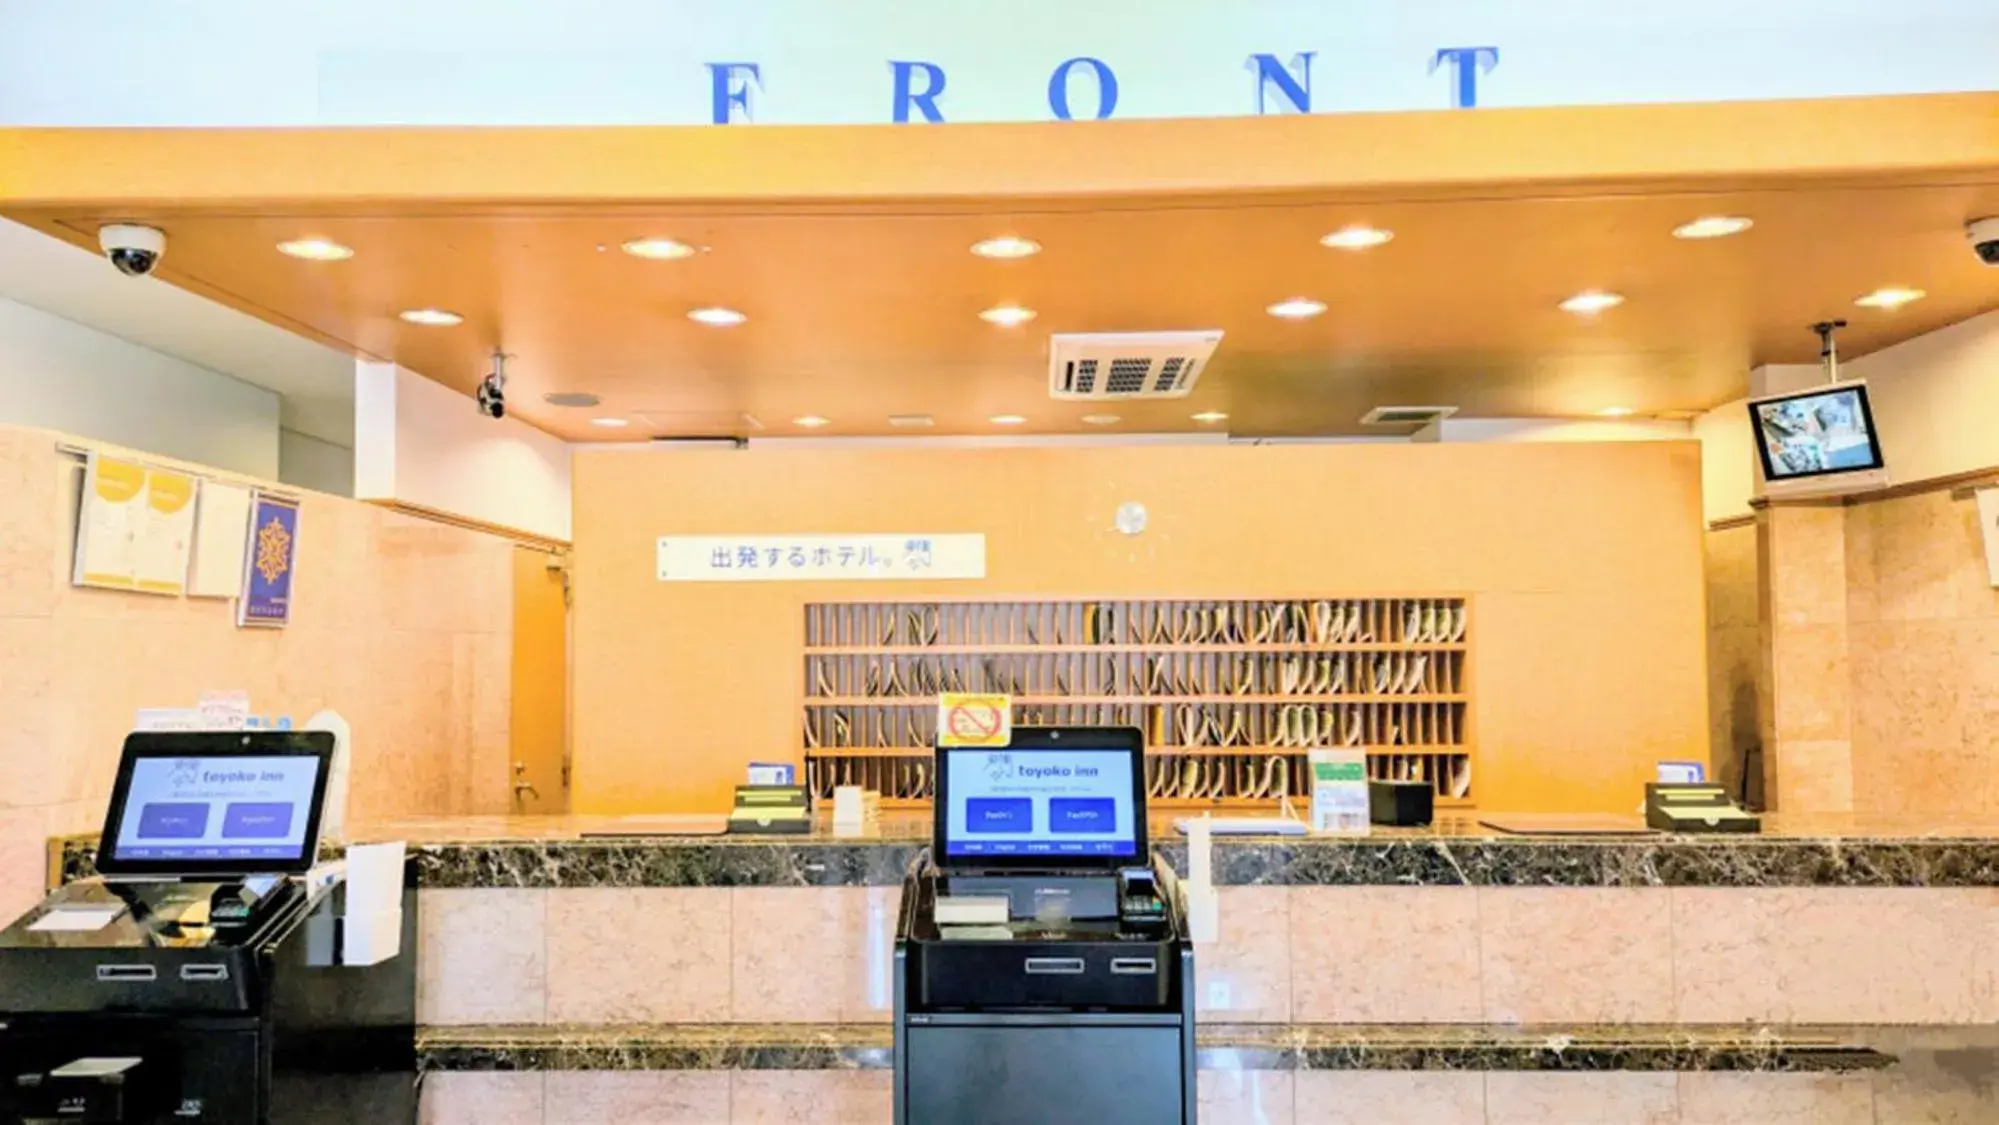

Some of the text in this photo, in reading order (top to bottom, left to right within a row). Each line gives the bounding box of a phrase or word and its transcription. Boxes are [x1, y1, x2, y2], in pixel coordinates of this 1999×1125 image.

[704, 46, 1499, 124] FRONT
[1018, 765, 1072, 779] toyoko
[1074, 764, 1099, 777] inn
